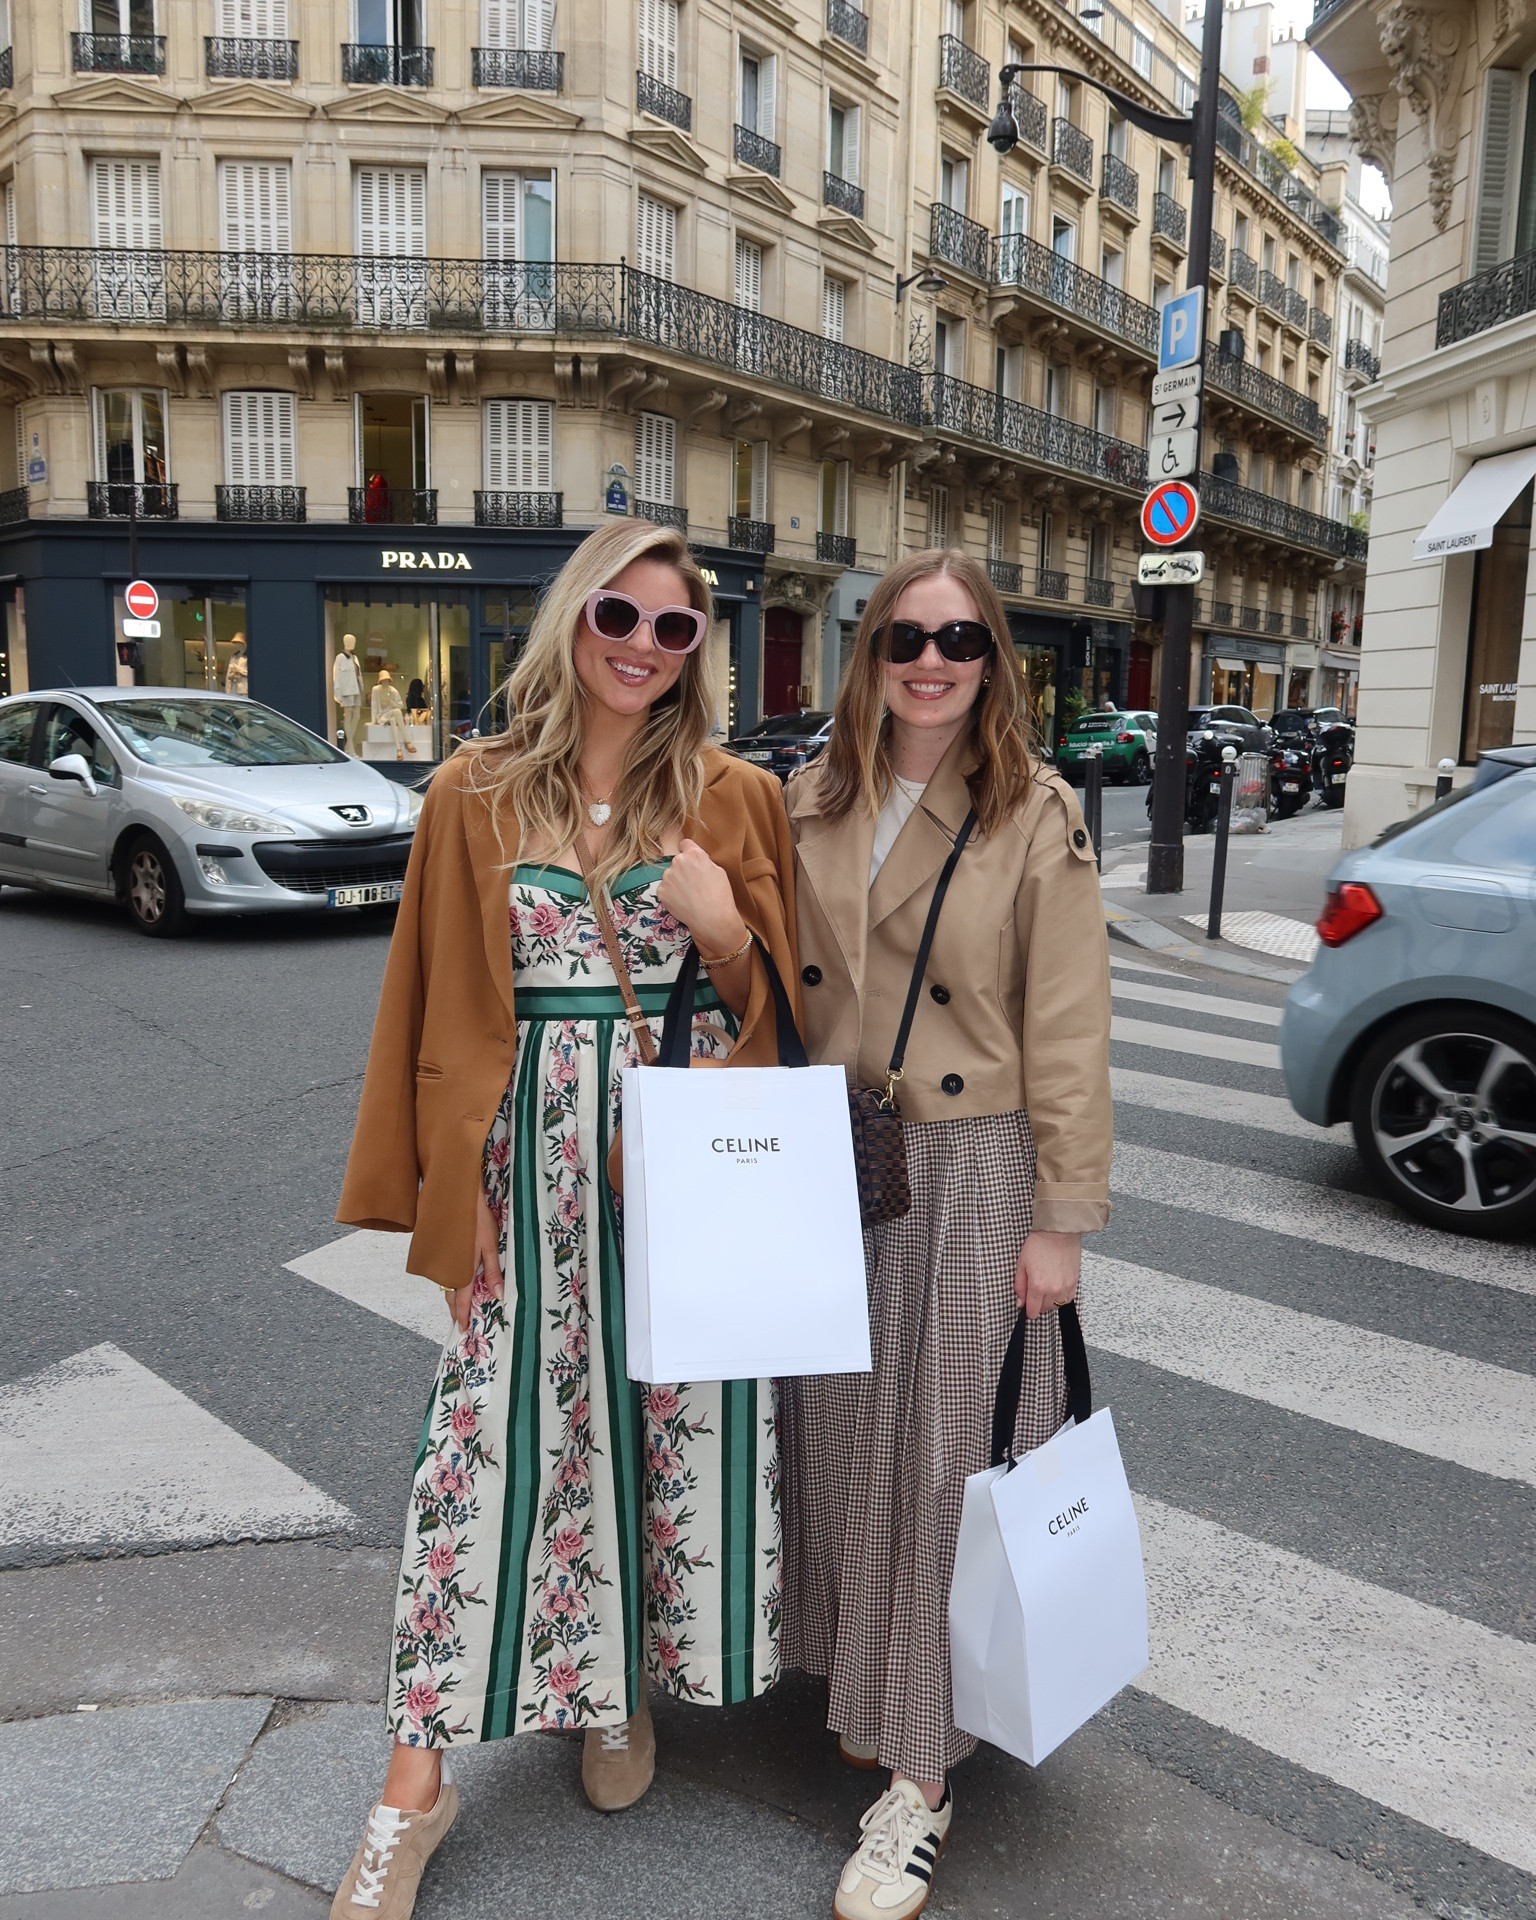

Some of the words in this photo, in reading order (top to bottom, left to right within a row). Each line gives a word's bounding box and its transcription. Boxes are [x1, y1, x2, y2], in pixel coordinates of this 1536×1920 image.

[1170, 309, 1188, 356] P
[1163, 375, 1197, 393] GERMAIN
[1428, 540, 1446, 553] SAINT
[1446, 534, 1477, 549] LAURENT
[381, 551, 473, 570] PRADA
[1479, 683, 1499, 694] SAINT
[711, 1138, 781, 1153] CELINE
[1048, 1497, 1089, 1535] CELINE
[1067, 1525, 1080, 1537] PARIS
